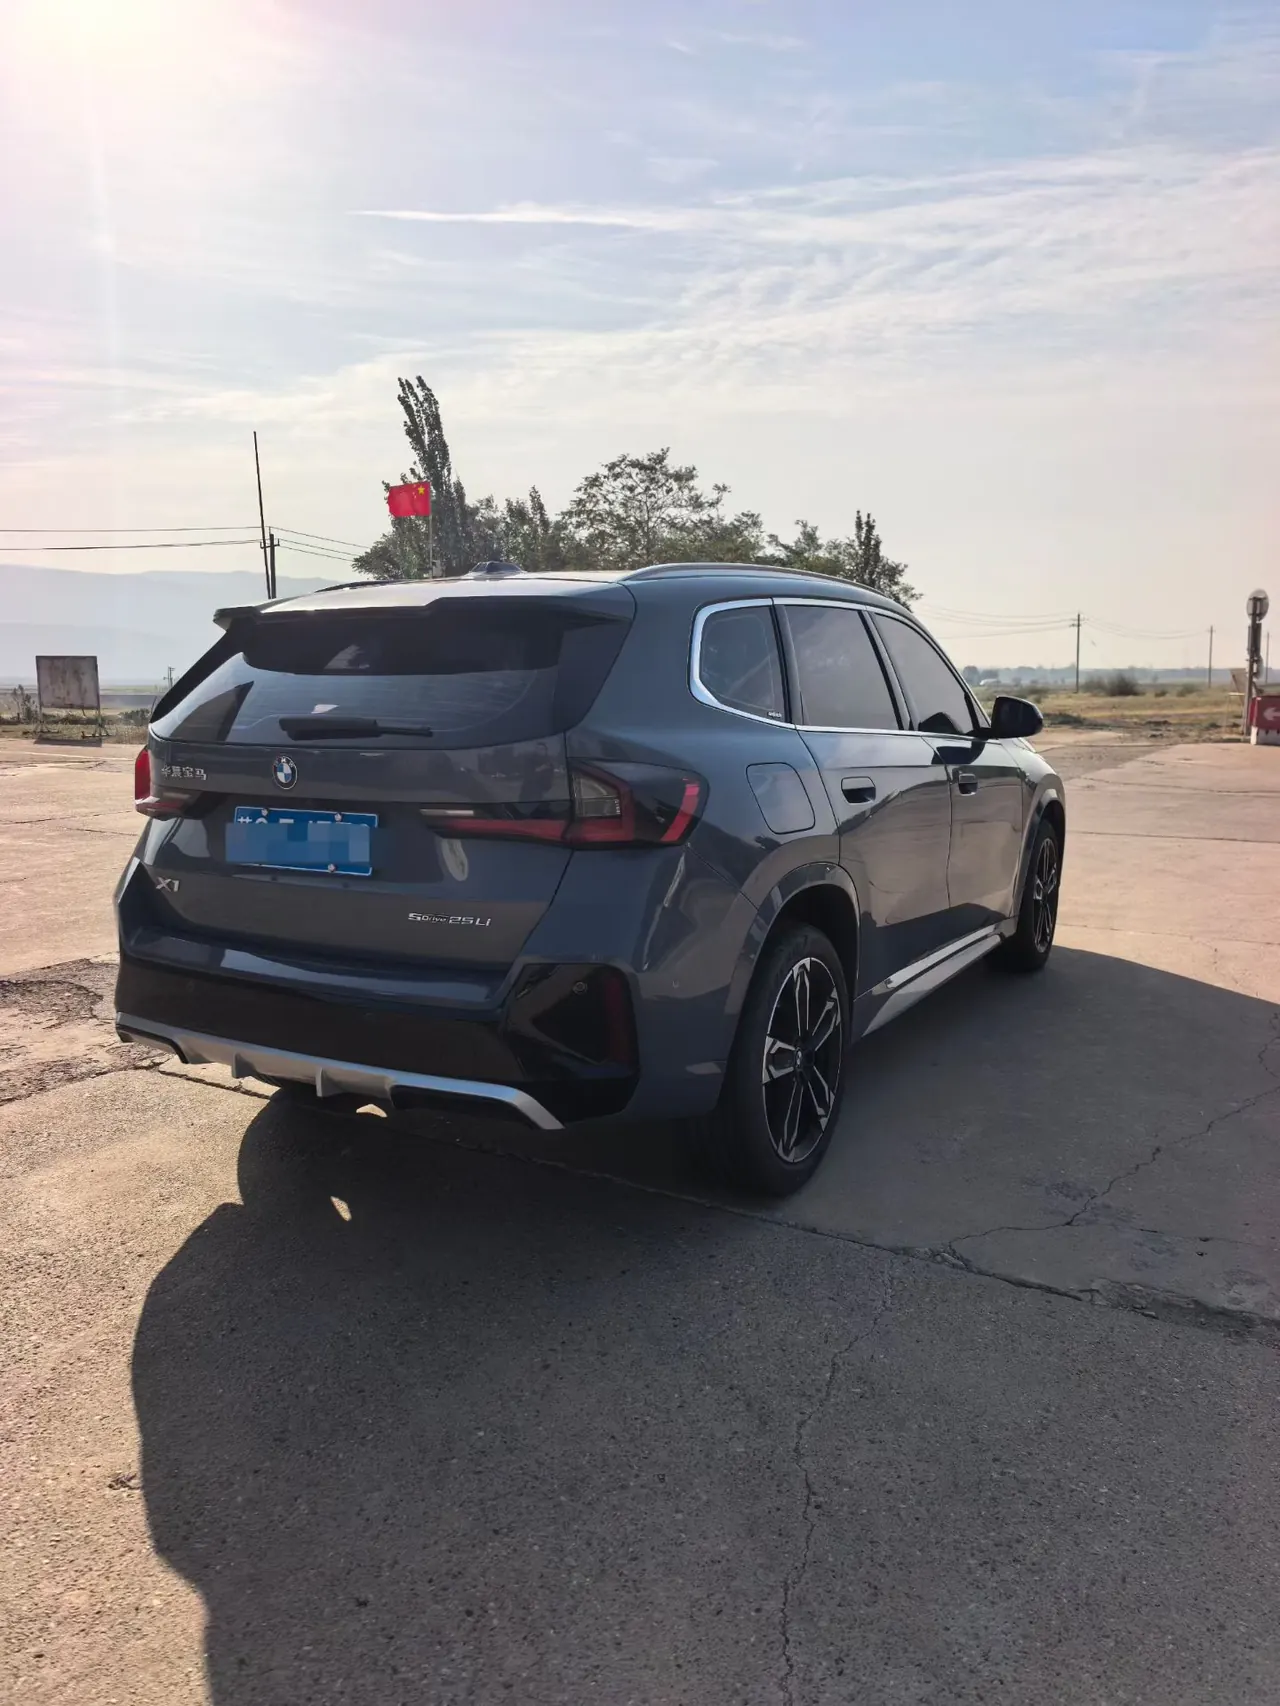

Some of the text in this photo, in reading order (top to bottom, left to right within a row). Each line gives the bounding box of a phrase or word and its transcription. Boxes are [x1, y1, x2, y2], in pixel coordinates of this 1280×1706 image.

[160, 765, 207, 781] 华晨宝马
[155, 876, 180, 893] X1
